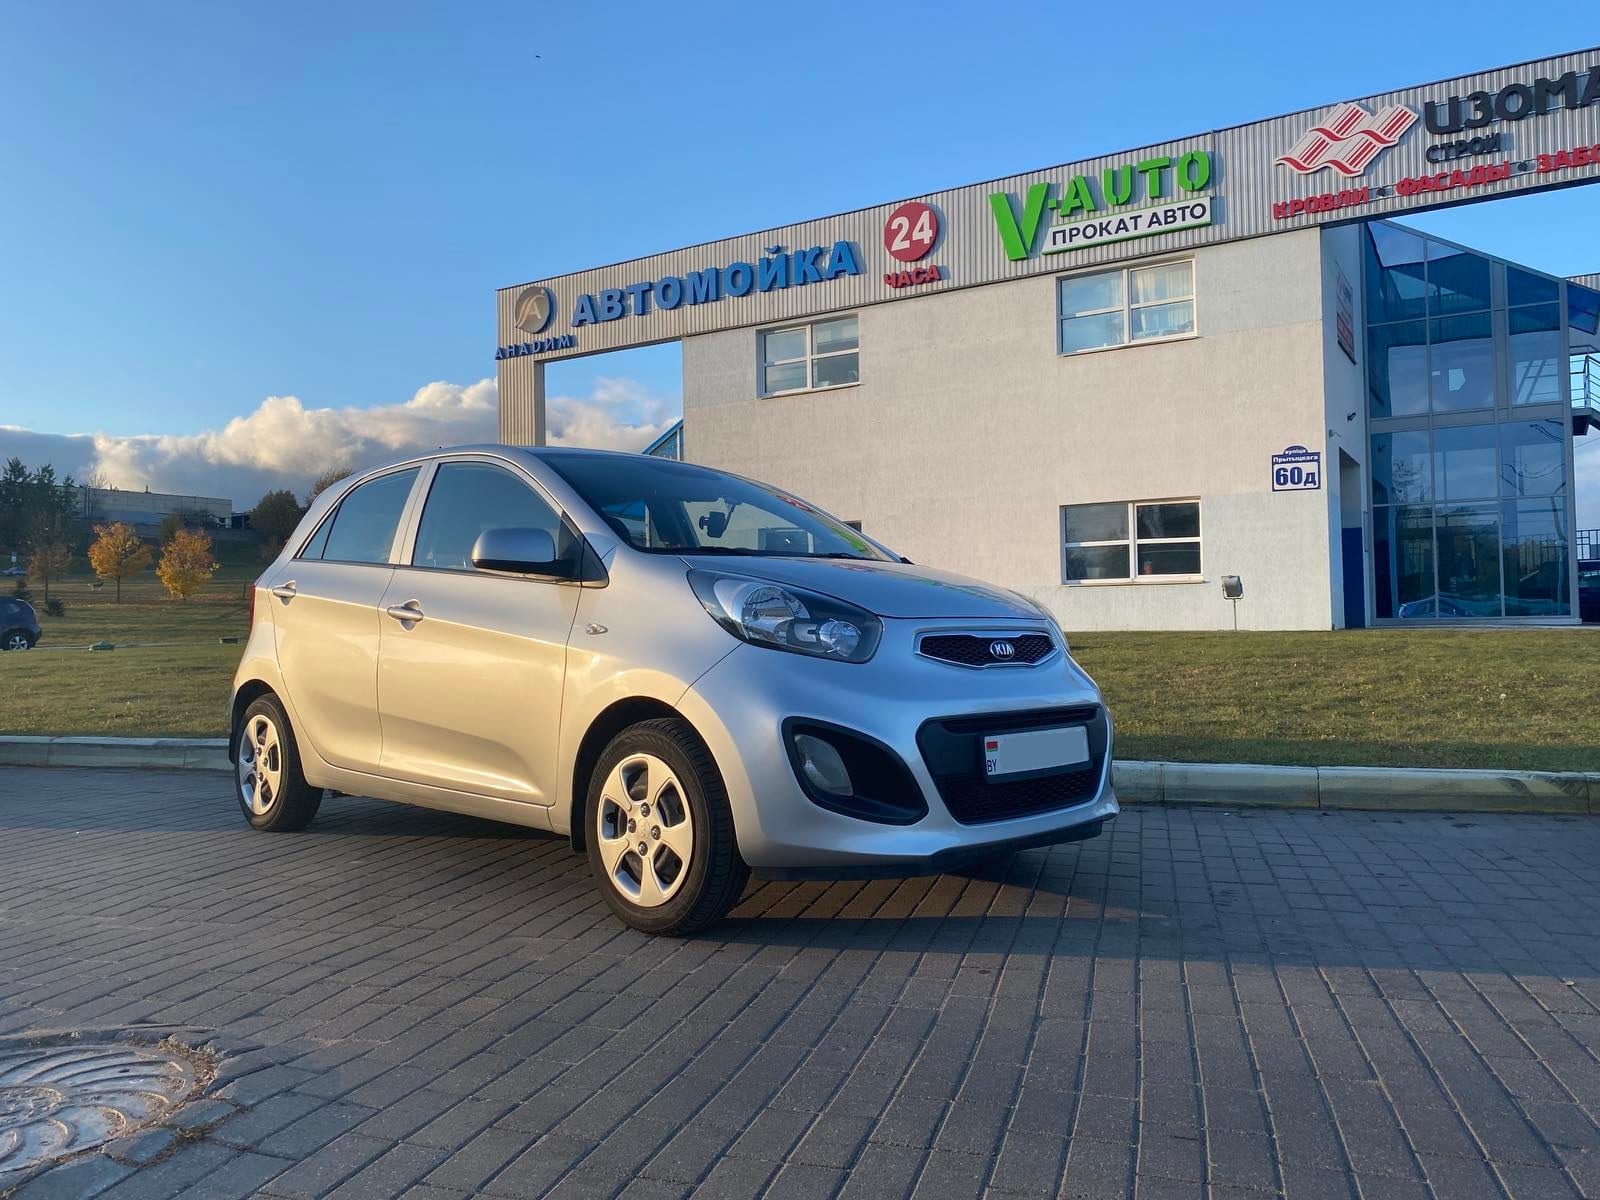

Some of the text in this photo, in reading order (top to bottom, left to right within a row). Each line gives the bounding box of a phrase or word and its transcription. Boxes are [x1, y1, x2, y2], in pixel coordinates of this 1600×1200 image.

[1426, 132, 1502, 164] СТРОЙ
[988, 150, 1211, 262] V-AUTO
[1273, 187, 1370, 220] КРОВЛИ
[1396, 160, 1511, 197] ФАСАДЫ
[891, 210, 933, 252] 24
[1052, 202, 1207, 246] ПРОКАТ АВТО
[571, 240, 860, 328] АВТОМОЙКА
[883, 264, 942, 288] ЧАСА
[993, 643, 1013, 656] KIA
[987, 758, 998, 772] BY
